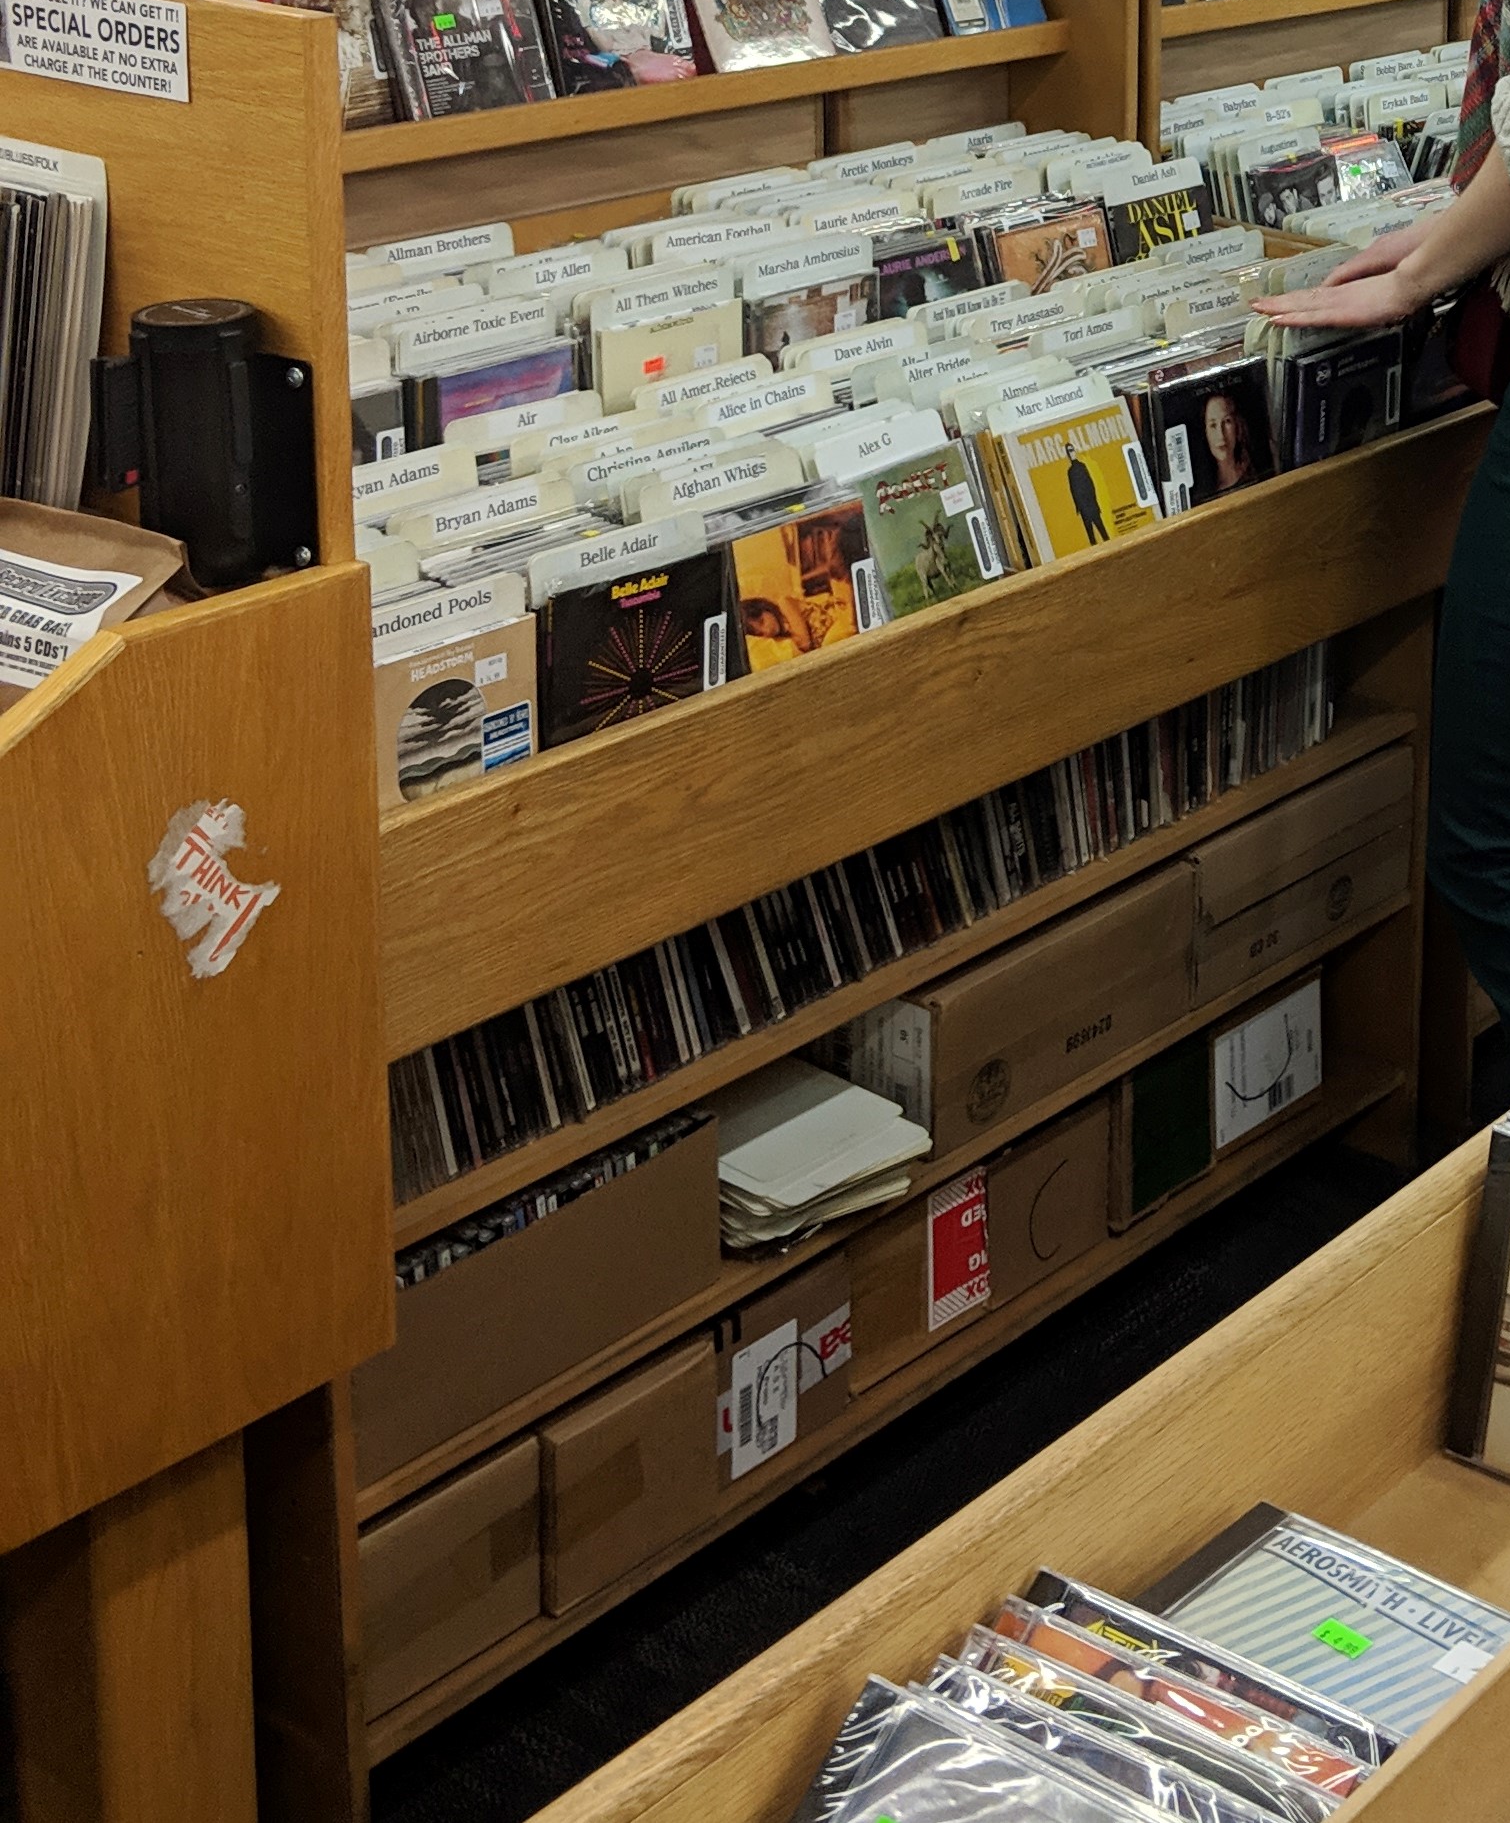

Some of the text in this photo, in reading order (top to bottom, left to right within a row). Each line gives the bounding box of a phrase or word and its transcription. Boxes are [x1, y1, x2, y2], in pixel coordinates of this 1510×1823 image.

[111, 0, 136, 16] CAN
[139, 4, 162, 21] GET
[165, 8, 179, 23] IT!
[12, 3, 180, 54] SPECIAL ORDERS
[417, 29, 492, 51] THE ALLMAN
[17, 34, 178, 75] ARE AVAILABLE AT NO EXTRA
[419, 46, 481, 63] BROTHERS
[24, 54, 172, 93] CHARGE AT THE COUNTER!
[1223, 99, 1257, 113] Babyface
[1382, 93, 1429, 110] Erykah Badu
[967, 133, 993, 148] Ataris
[1260, 138, 1298, 154] Augustines
[840, 152, 914, 179] Arctic Monkeys
[1132, 167, 1176, 186] Daniel Ash
[960, 178, 1013, 201] Arcade Fire
[814, 204, 899, 232] Laurie Anderson
[1126, 190, 1197, 224] DANIEL
[386, 231, 492, 262] Allman Brothers
[666, 231, 722, 249] American
[757, 244, 861, 278] Marsha Ambrosius
[1186, 241, 1244, 266] Joseph Arthur
[535, 262, 591, 285] Lily Allen
[879, 257, 910, 276] LAURIE
[615, 278, 718, 313] All Them Witches
[1188, 291, 1240, 315] Fiona Apple
[412, 306, 545, 346] Airborne Toxic Event
[990, 303, 1064, 333] Trey Anastasio
[1063, 320, 1113, 343] Tori Amos
[834, 336, 893, 362] Dave Alvin
[908, 365, 943, 383] Alter
[660, 390, 678, 406] All
[718, 384, 806, 422] Alice in Chains
[1001, 382, 1039, 402] Almost
[1015, 387, 1084, 418] Marc Almond
[516, 412, 538, 428] Air
[857, 433, 892, 460] Alex G
[1022, 414, 1129, 467] MARC ALMOND
[389, 463, 440, 488] Adams
[672, 460, 768, 502] Afghan Whigs
[435, 494, 538, 534] Bryan Adams
[580, 533, 659, 568] Belle Adair
[611, 573, 670, 600] Belle Adair
[448, 590, 492, 615] Pools
[10, 609, 39, 628] GRAB
[23, 636, 31, 653] 5
[176, 836, 250, 910] THINK
